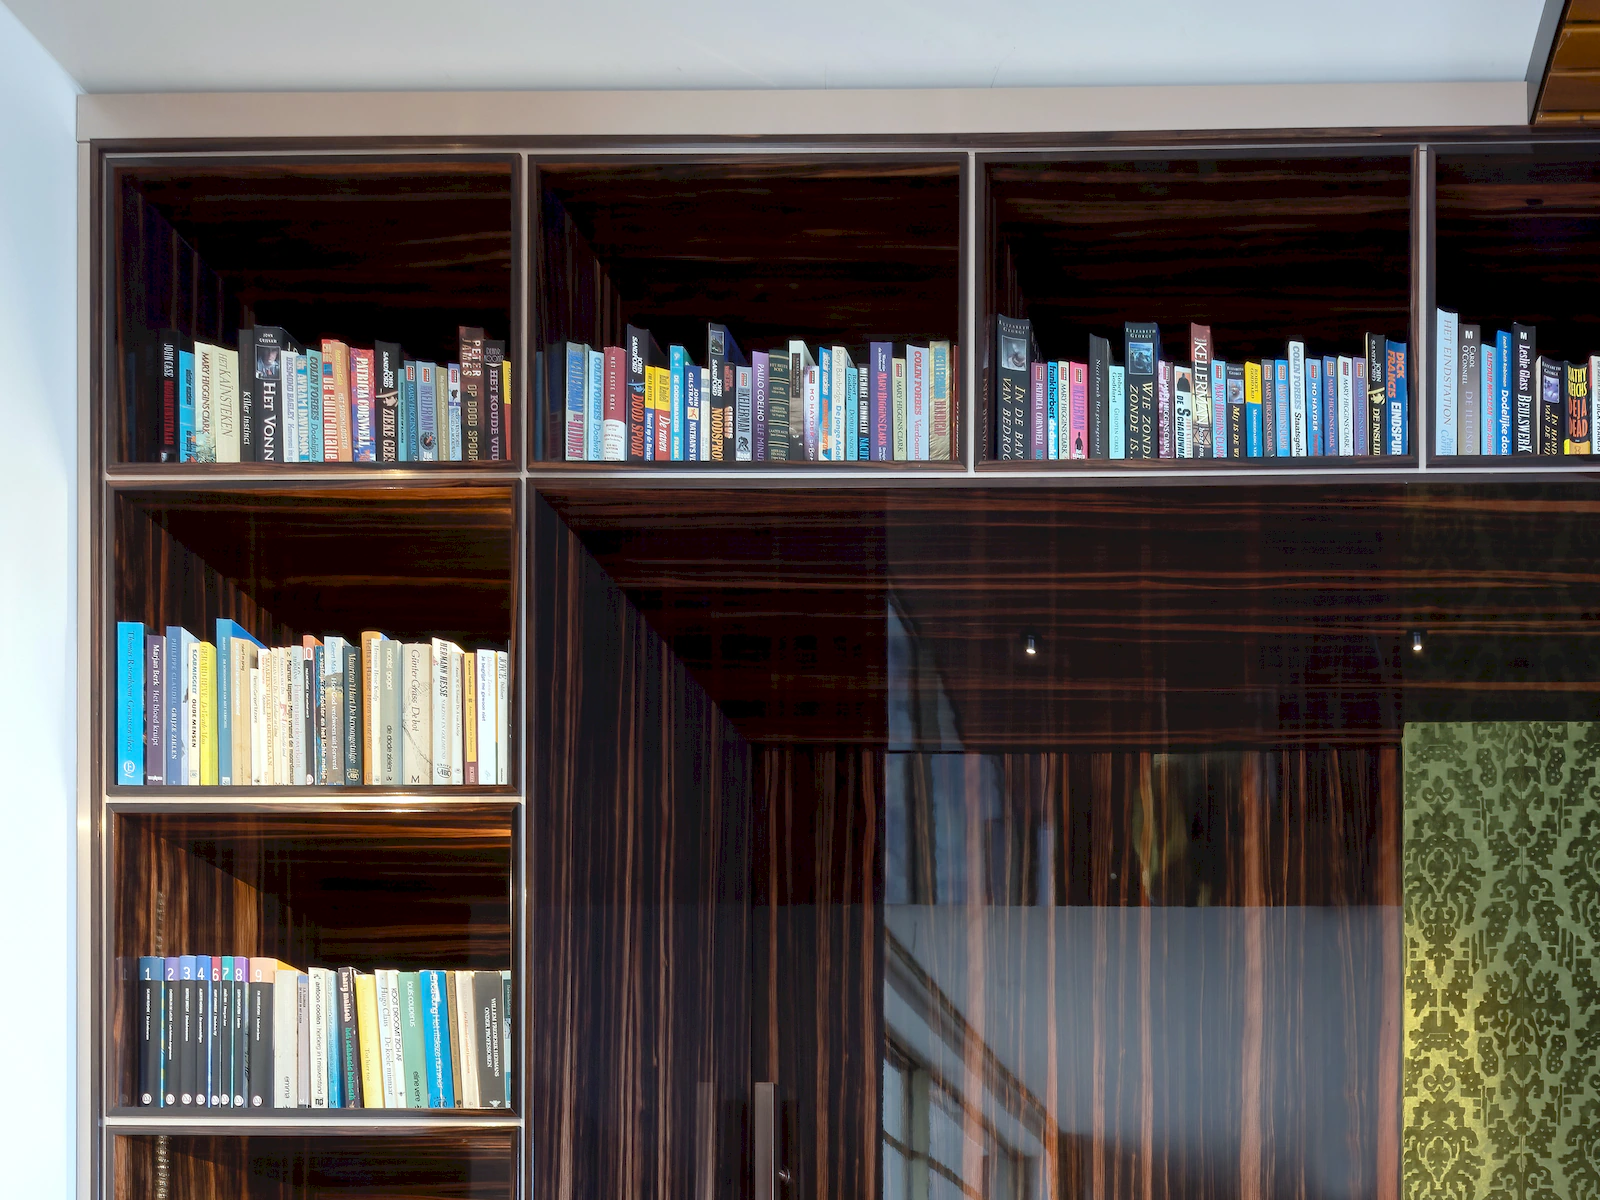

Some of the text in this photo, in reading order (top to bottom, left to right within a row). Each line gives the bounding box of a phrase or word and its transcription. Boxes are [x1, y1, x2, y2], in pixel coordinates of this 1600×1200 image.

[1520, 332, 1528, 340] M
[462, 339, 472, 377] JAMES
[475, 340, 483, 377] PETER
[1396, 351, 1405, 379] DICK
[1461, 345, 1470, 386] O'CONNELL
[1469, 345, 1477, 368] CAROL
[1387, 349, 1396, 398] FRANCIS
[1443, 319, 1453, 426] HET EINDSTATION
[1567, 365, 1587, 382] KATHY
[201, 351, 211, 435] MARY HIGGINS CLARK
[218, 353, 234, 438] HET KAÏNSTEKEN
[243, 391, 252, 414] Killer
[264, 382, 275, 411] HET
[357, 357, 371, 448] PATRICIA CORNWELL
[809, 388, 816, 402] MO
[1176, 394, 1184, 405] DE
[1311, 382, 1318, 396] MO
[1465, 391, 1473, 407] DE
[1517, 343, 1533, 454] Leslie Glass BEULSWERK
[1567, 381, 1588, 398] REICHS
[310, 357, 320, 458] COLIN FORBES Dodelijke
[420, 391, 435, 431] KELLERMAN
[724, 405, 734, 439] CIRCUS
[738, 392, 750, 433] KELLERMAN
[859, 367, 869, 461] MICHAEL CONNELLY NACHT
[877, 371, 888, 447] MARY HIGGINS CLARK
[1014, 385, 1026, 459] IN DE BAN
[1035, 382, 1044, 446] PATRICIA CORNWELL
[1072, 389, 1085, 431] KELLERMAN
[1311, 397, 1319, 431] HAYDER
[1552, 413, 1559, 426] IN
[243, 415, 252, 446] instinct
[467, 384, 478, 461] OP DOOD SPOOR
[631, 394, 644, 457] DOOD SPOOR
[1569, 417, 1589, 438] DEAD
[498, 656, 507, 680] JOYCE
[127, 630, 136, 753] Thomas Rosenboom Gewassen vlees
[151, 644, 161, 747] Marjan Berk Het bloed kruipt
[410, 648, 420, 732] Günter Grass De bot
[170, 707, 178, 733] GRIJZE
[170, 733, 178, 760] ZIELEN
[411, 775, 420, 784] M
[145, 967, 152, 981] 1
[167, 967, 175, 982] 2
[183, 966, 191, 981] 3
[197, 967, 206, 981] 4
[212, 968, 219, 982] 6
[222, 967, 230, 981] 7
[235, 968, 243, 982] 8
[255, 969, 262, 983] 9
[392, 1006, 400, 1037] DROOMT
[491, 1021, 499, 1050] FREDERIK
[395, 1053, 402, 1062] AF
